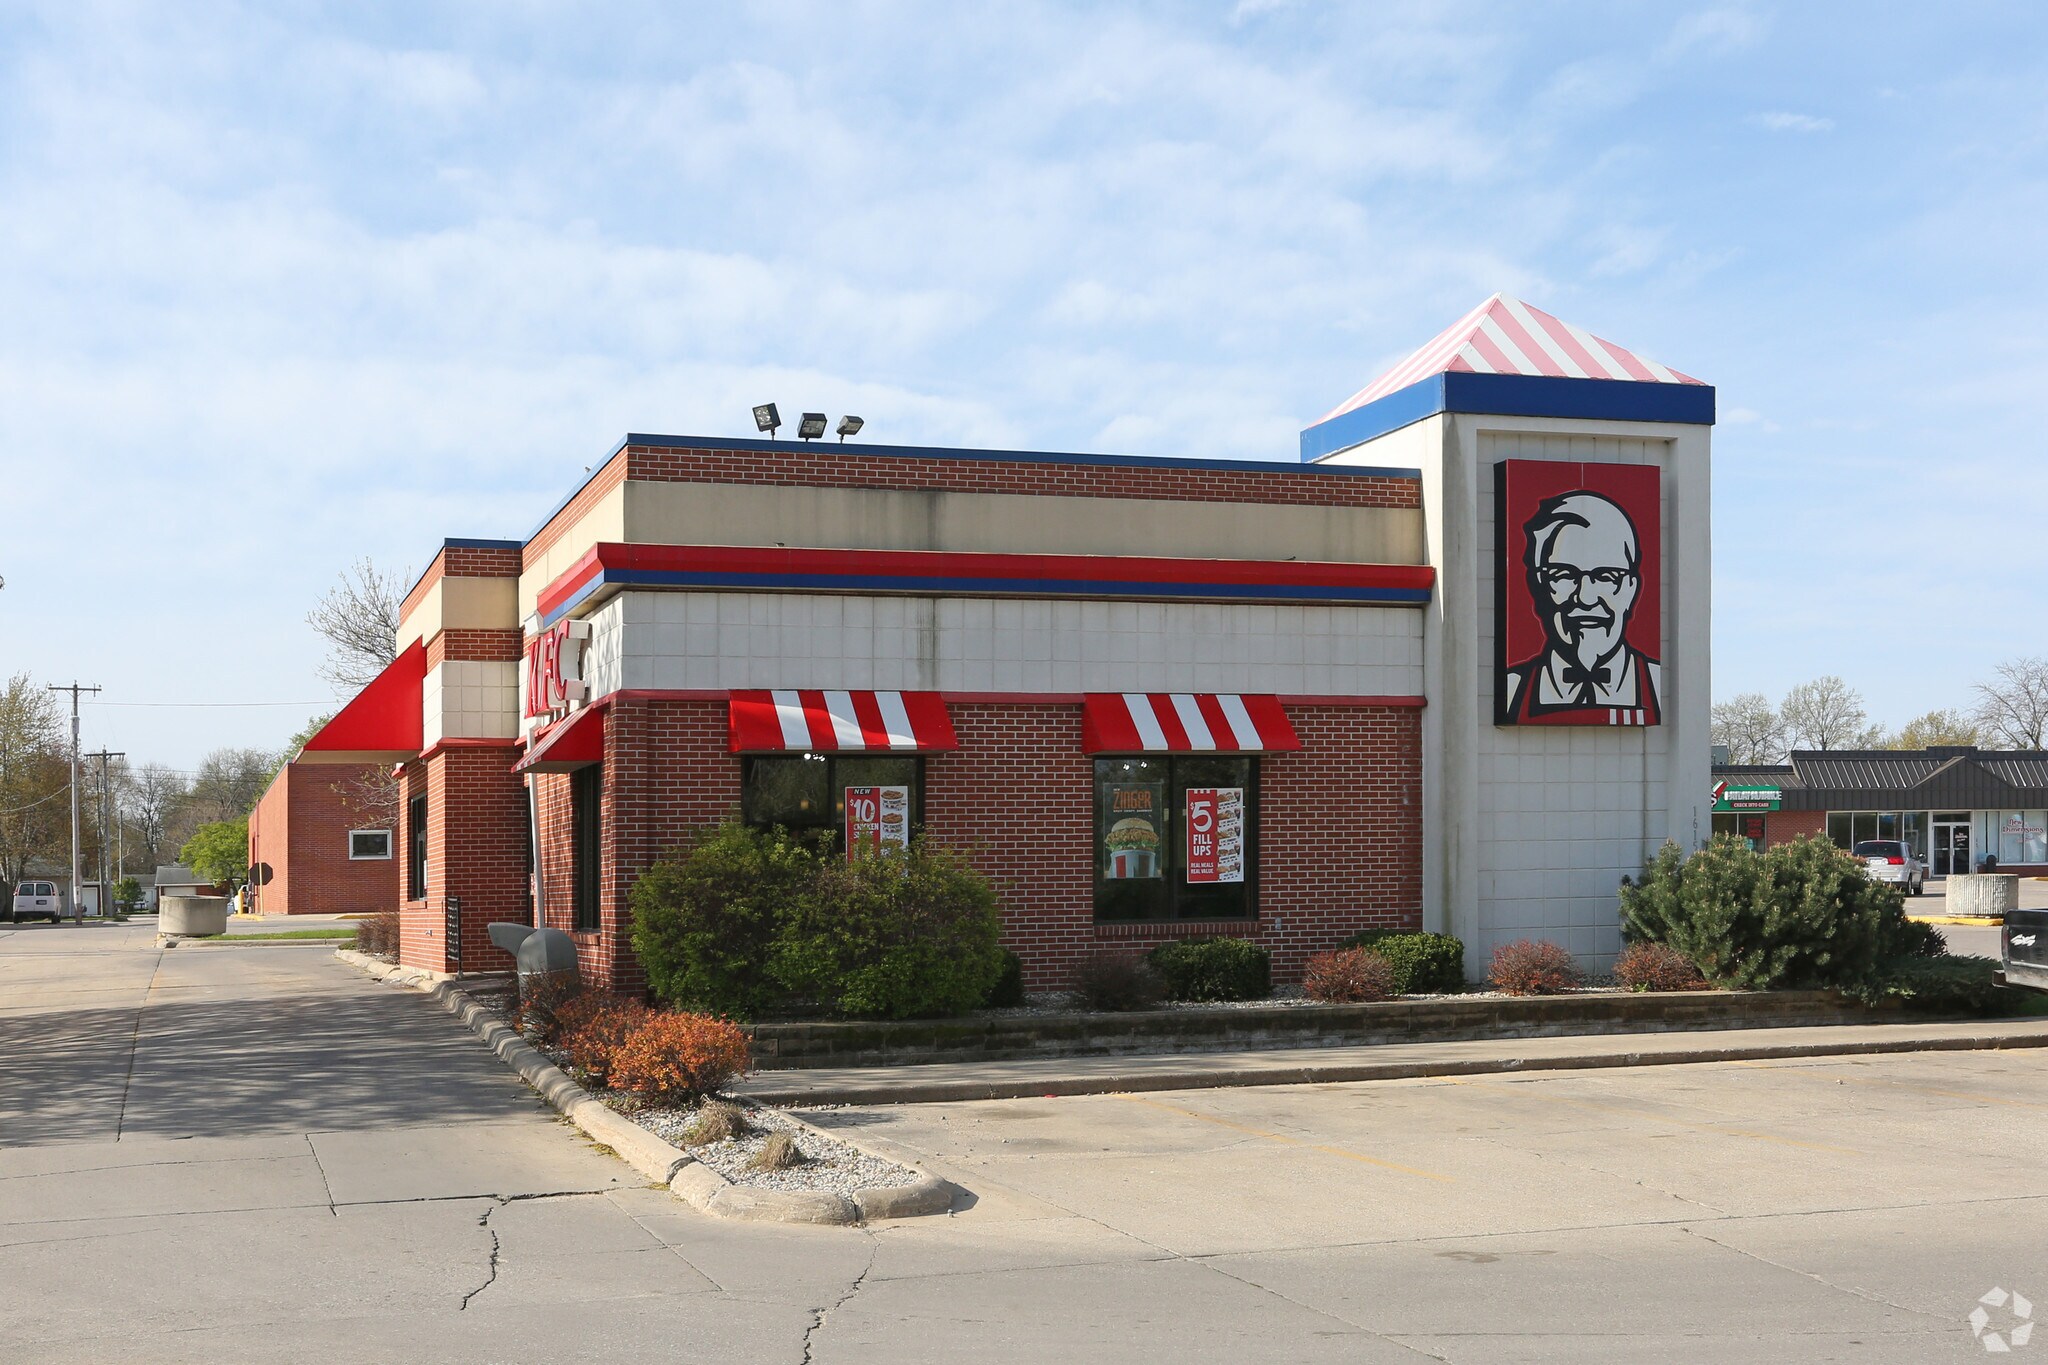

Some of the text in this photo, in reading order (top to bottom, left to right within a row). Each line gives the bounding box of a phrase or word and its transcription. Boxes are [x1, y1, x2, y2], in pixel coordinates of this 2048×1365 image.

[524, 619, 588, 719] KFC
[850, 799, 875, 822] $10
[1190, 801, 1213, 832] $5
[1193, 834, 1213, 845] FILL
[1193, 846, 1212, 856] UPS
